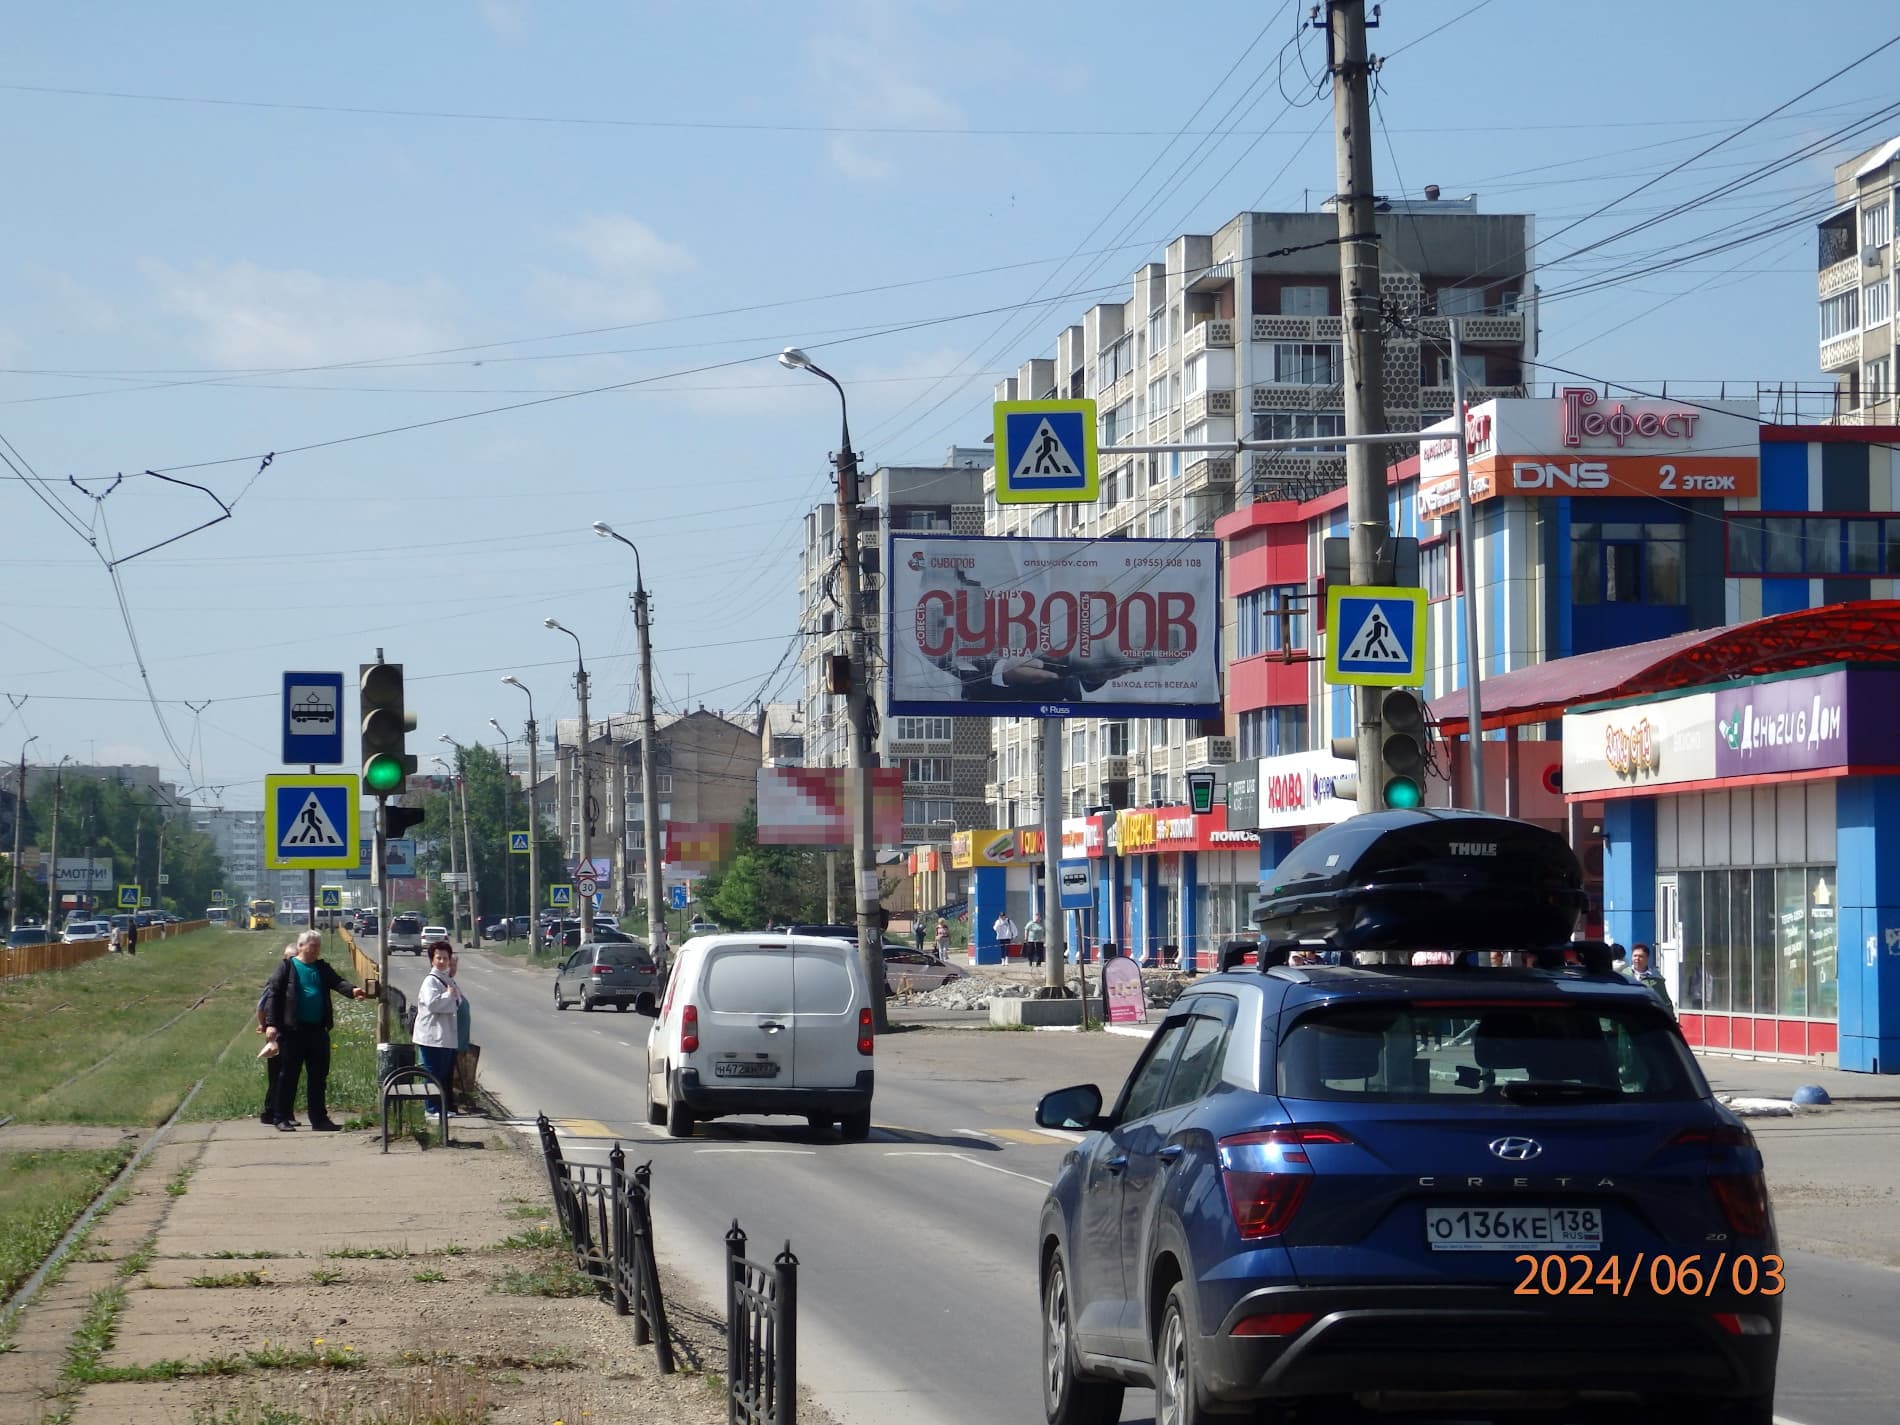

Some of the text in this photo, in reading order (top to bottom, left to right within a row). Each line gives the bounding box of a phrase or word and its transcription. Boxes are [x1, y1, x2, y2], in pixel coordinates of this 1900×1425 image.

[1561, 387, 1699, 447] Гефест
[1513, 462, 1608, 489] DNS
[1659, 465, 1735, 490] 2 этаж
[930, 557, 976, 568] СУВОРОВ
[1125, 558, 1131, 567] 8
[1133, 558, 1163, 568] (3955)
[1186, 558, 1202, 568] 108
[984, 590, 1023, 600] УСПЕХ
[915, 590, 1198, 658] СУВОРОВ
[916, 603, 926, 647] СОВЕСТЬ
[1081, 594, 1090, 656] РАЗУМНОСТЬ
[1040, 621, 1050, 652] ОЧАГ
[1002, 647, 1033, 658] ВЕРА
[1112, 680, 1198, 689] ВЫХОД ЕСТЬ ВСЕГДА!
[1050, 705, 1070, 714] Russ
[1740, 704, 1795, 759] Деньги
[1796, 710, 1806, 744] в
[1807, 695, 1841, 752] Дом
[1449, 842, 1497, 856] THULE
[582, 883, 593, 892] 30
[1418, 1177, 1614, 1187] CRETA
[1434, 1211, 1595, 1239] О136КЕ 138
[1562, 1231, 1583, 1240] RUS
